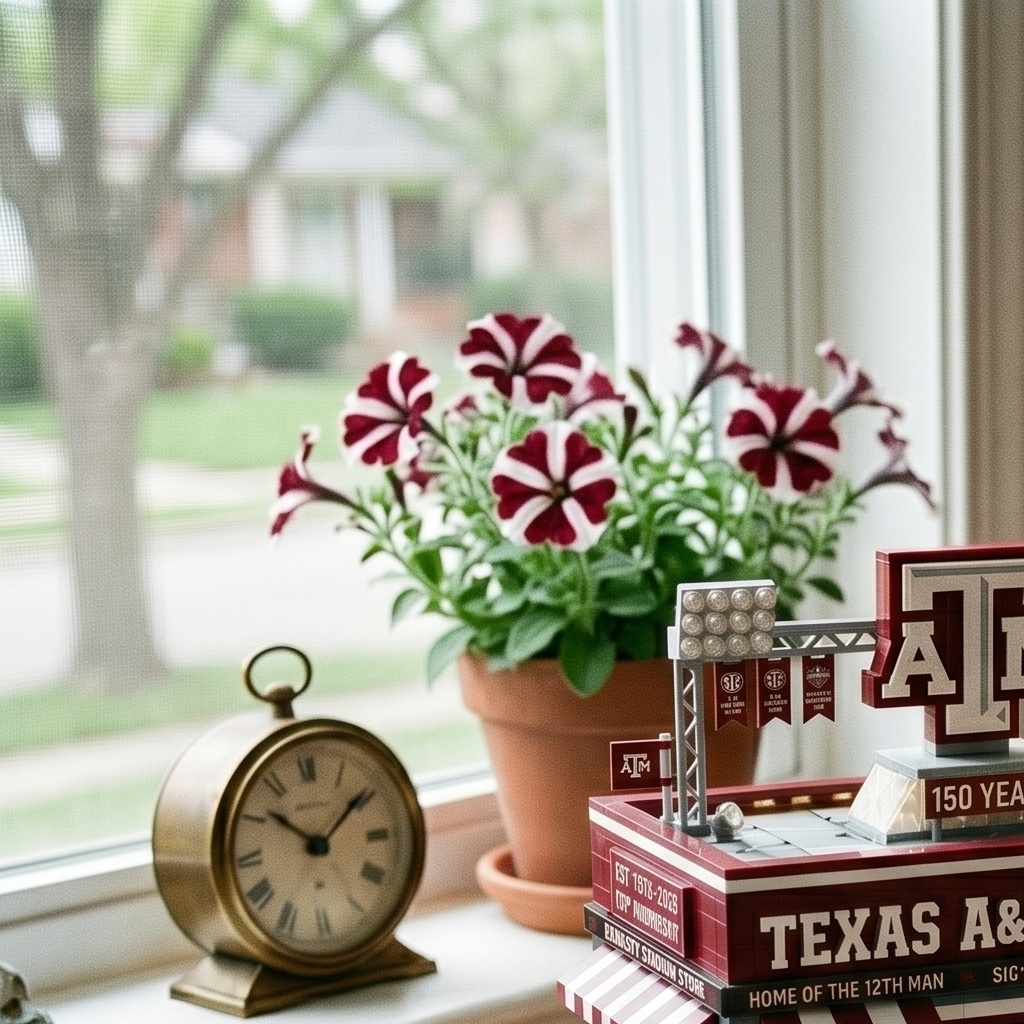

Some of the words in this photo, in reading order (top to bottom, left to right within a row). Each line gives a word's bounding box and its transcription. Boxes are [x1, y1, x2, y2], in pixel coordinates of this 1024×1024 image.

[931, 784, 973, 813] 150
[759, 901, 941, 970] TEXAS
[749, 987, 798, 1009] HOME
[802, 984, 824, 1003] OF
[827, 980, 860, 1001] THE
[864, 976, 903, 997] 12TH
[908, 972, 944, 993] MAN
